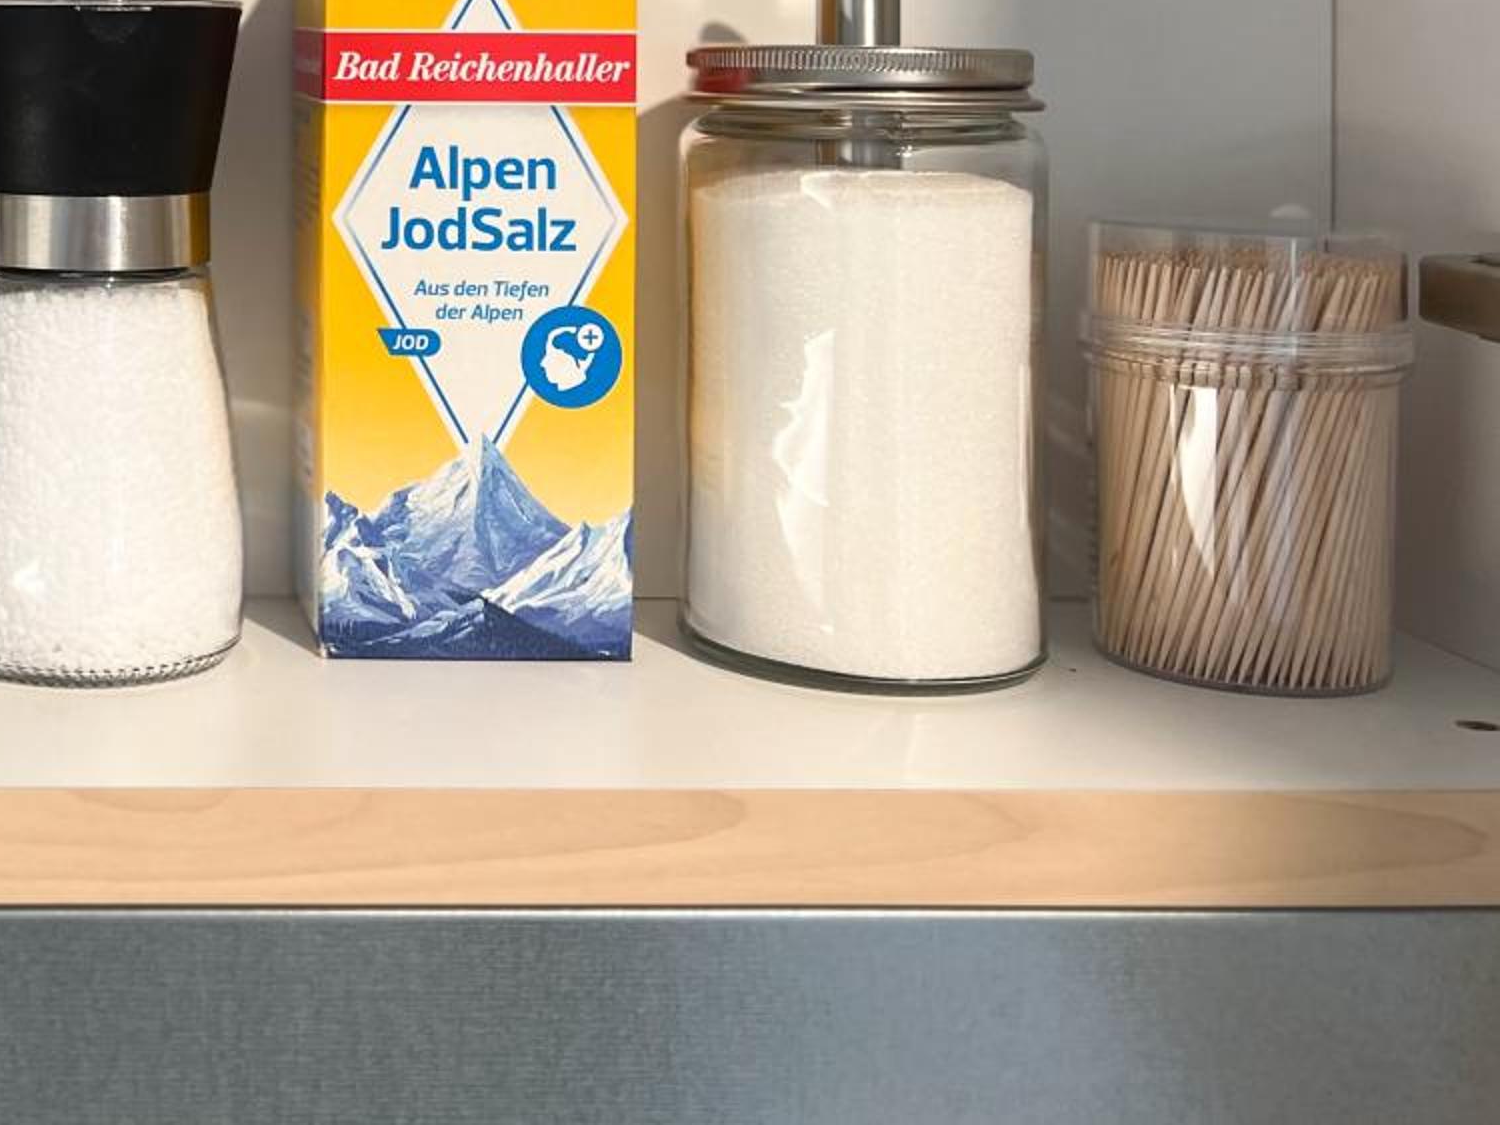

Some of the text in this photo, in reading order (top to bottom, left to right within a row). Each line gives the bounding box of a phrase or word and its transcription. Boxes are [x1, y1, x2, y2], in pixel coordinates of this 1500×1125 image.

[334, 51, 401, 83] Bad
[409, 51, 630, 84] Reichenhaller
[408, 145, 557, 202] Alpen
[381, 206, 576, 252] JodSalz
[414, 278, 549, 300] Aus den Tiefen
[435, 302, 523, 323] der Alpen
[391, 333, 429, 352] JOD
